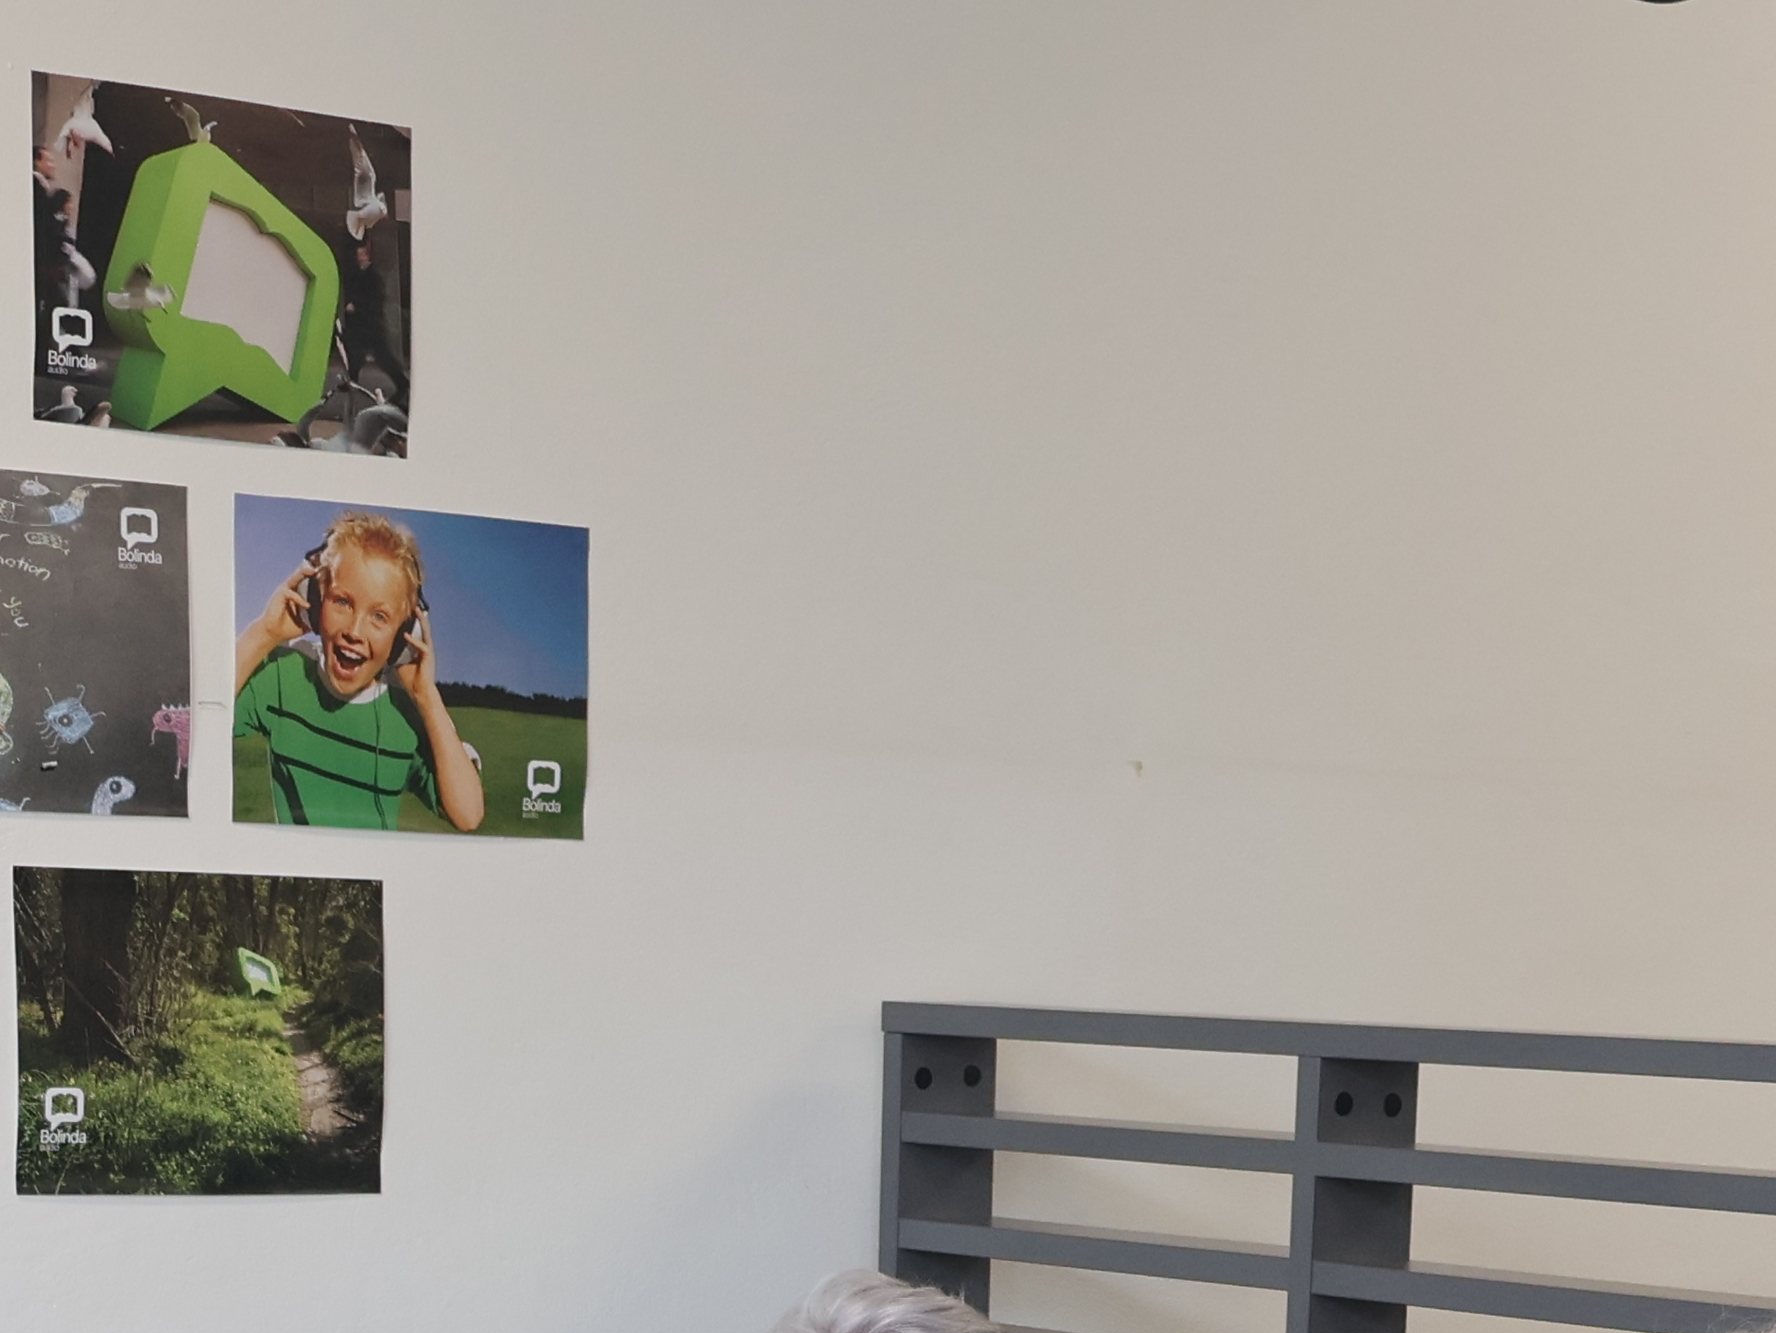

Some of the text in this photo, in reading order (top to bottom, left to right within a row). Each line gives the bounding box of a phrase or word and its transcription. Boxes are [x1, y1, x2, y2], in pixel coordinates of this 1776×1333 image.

[48, 349, 97, 370] Bolinda
[117, 546, 163, 565] Bolinda
[2, 596, 30, 628] you
[522, 797, 561, 814] Bolinda
[40, 1129, 87, 1144] Bolinda
